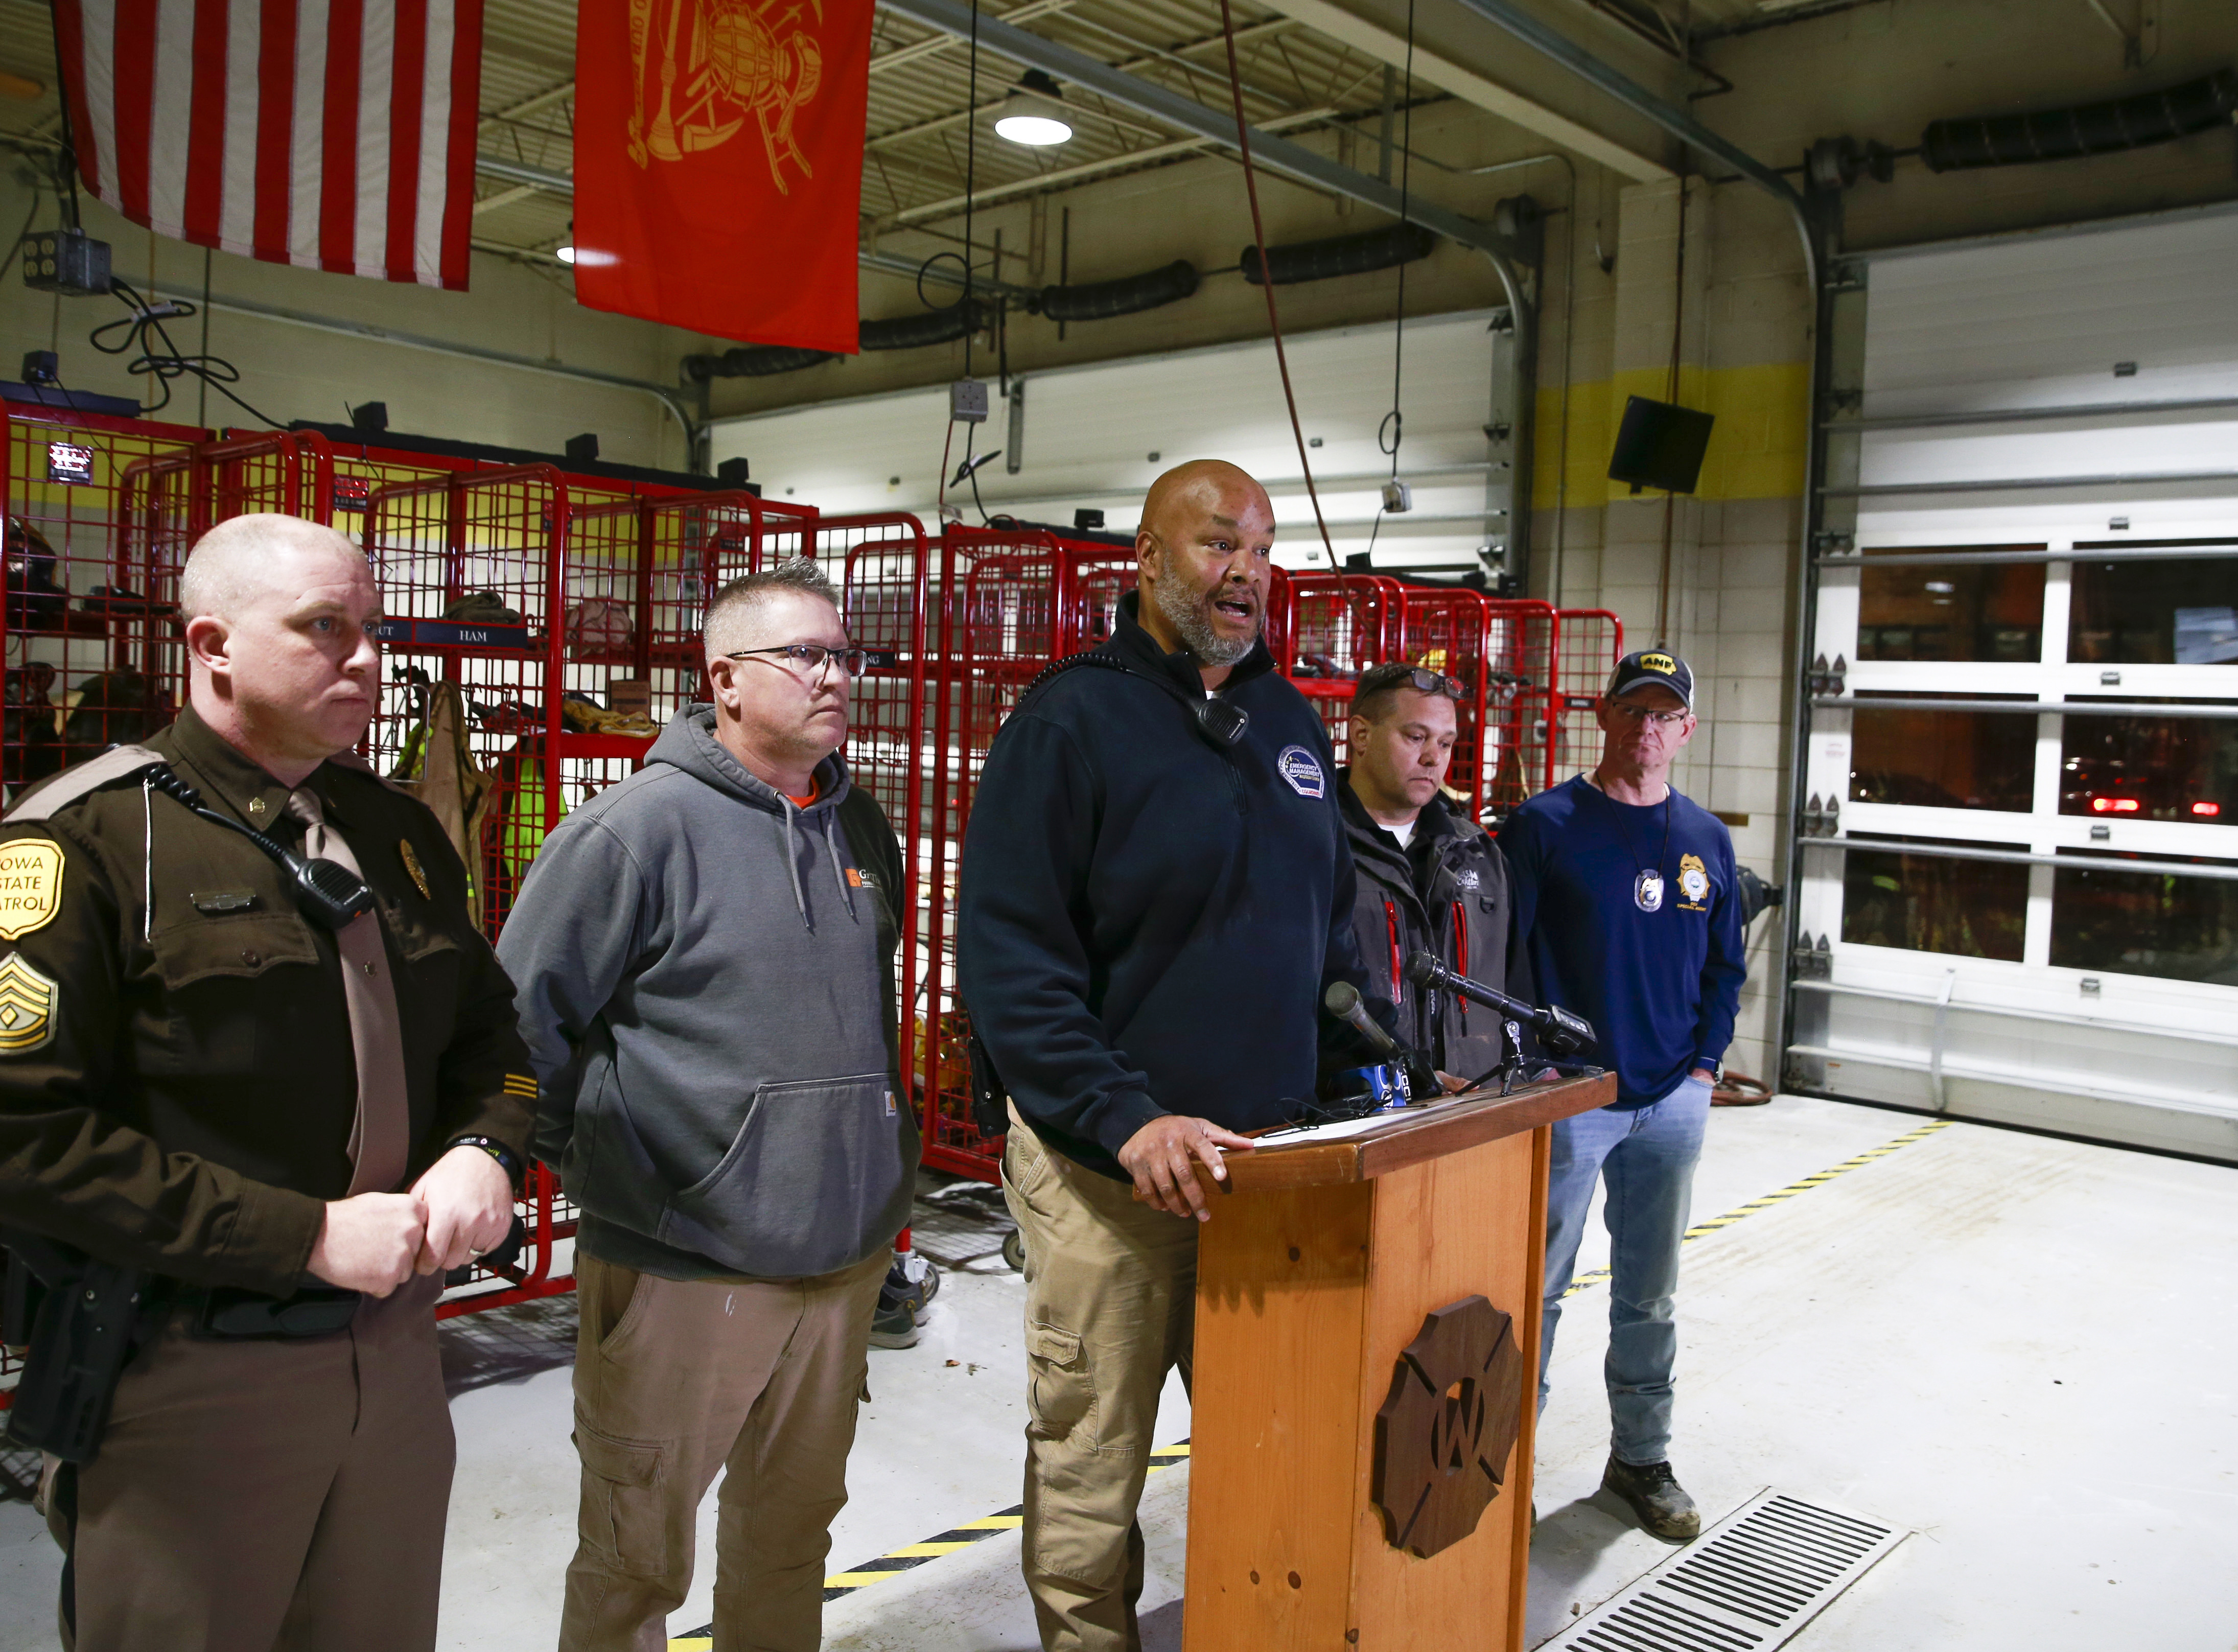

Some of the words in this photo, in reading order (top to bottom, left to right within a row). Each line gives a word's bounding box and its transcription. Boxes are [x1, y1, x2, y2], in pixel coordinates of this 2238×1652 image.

[375, 626, 394, 636] UT
[460, 630, 487, 642] HAM
[867, 655, 879, 665] NG
[1289, 768, 1320, 777] MANAGEMENT
[1290, 763, 1317, 771] EMERGENCY
[0, 857, 43, 870] OWA
[0, 897, 47, 911] TROL
[1402, 1064, 1412, 1102] CCI
